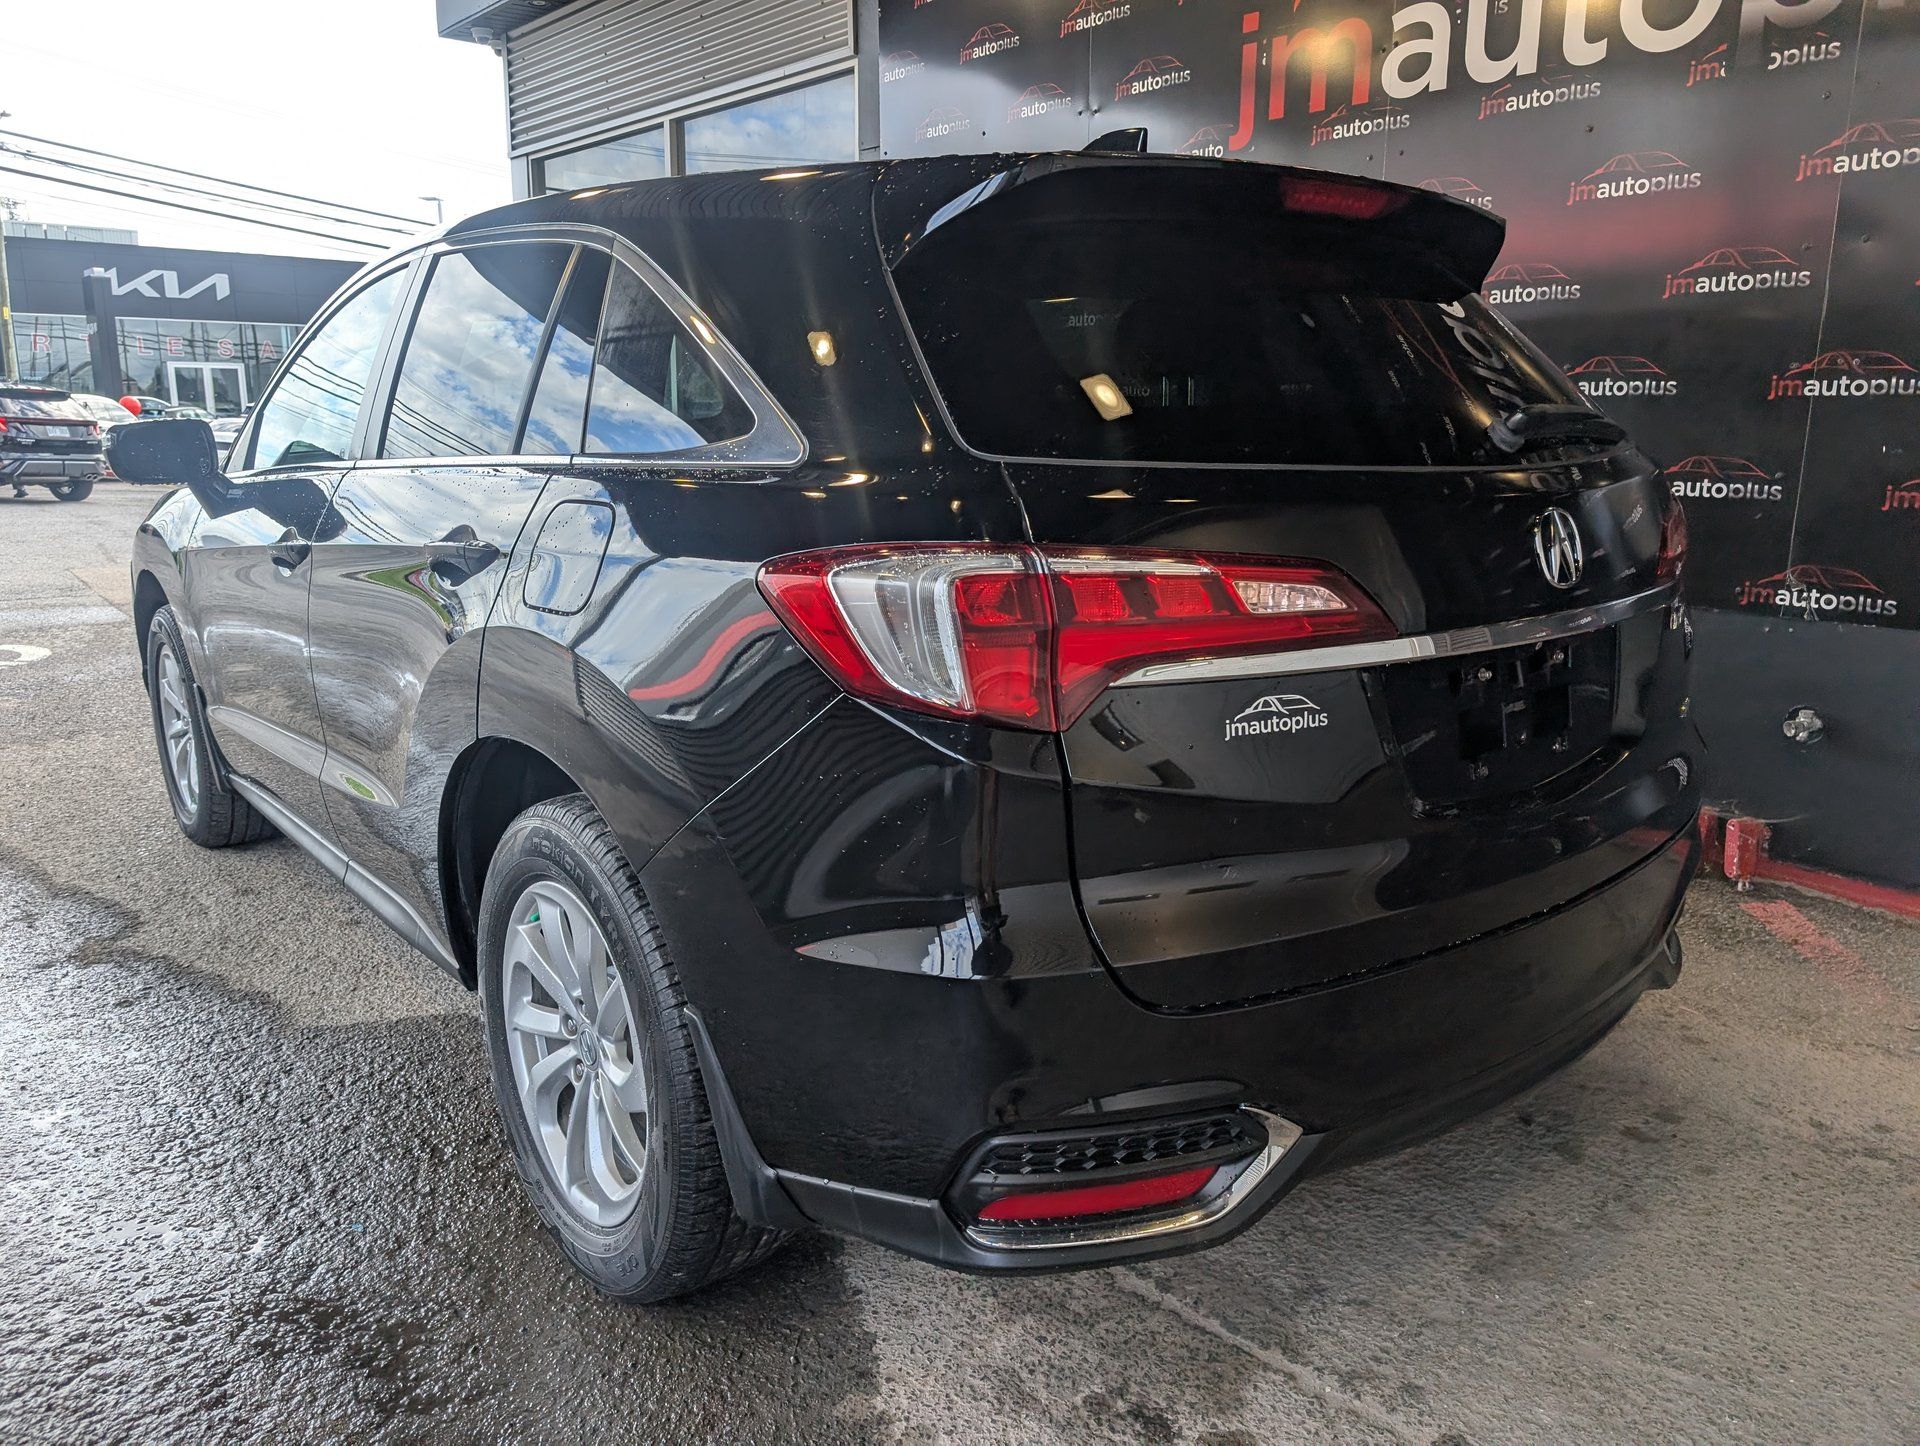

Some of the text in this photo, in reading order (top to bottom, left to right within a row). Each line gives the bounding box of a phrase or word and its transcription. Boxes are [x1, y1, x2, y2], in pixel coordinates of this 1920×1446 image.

[1060, 4, 1131, 38] jmautoplus
[960, 35, 1020, 65] jmautoplus
[1115, 69, 1191, 101] jmautoplus
[1478, 81, 1602, 120] jmautoplus
[1007, 96, 1072, 124] jmautoplus
[915, 118, 971, 143] jmautoplus
[1311, 113, 1411, 146] jmautoplus
[1567, 172, 1702, 205] jmautoplus
[1662, 269, 1812, 299] jmautoplus
[1671, 478, 1782, 501] autoplus
[1739, 581, 1898, 616] jmautoplus
[1224, 711, 1328, 741] jmautoplus
